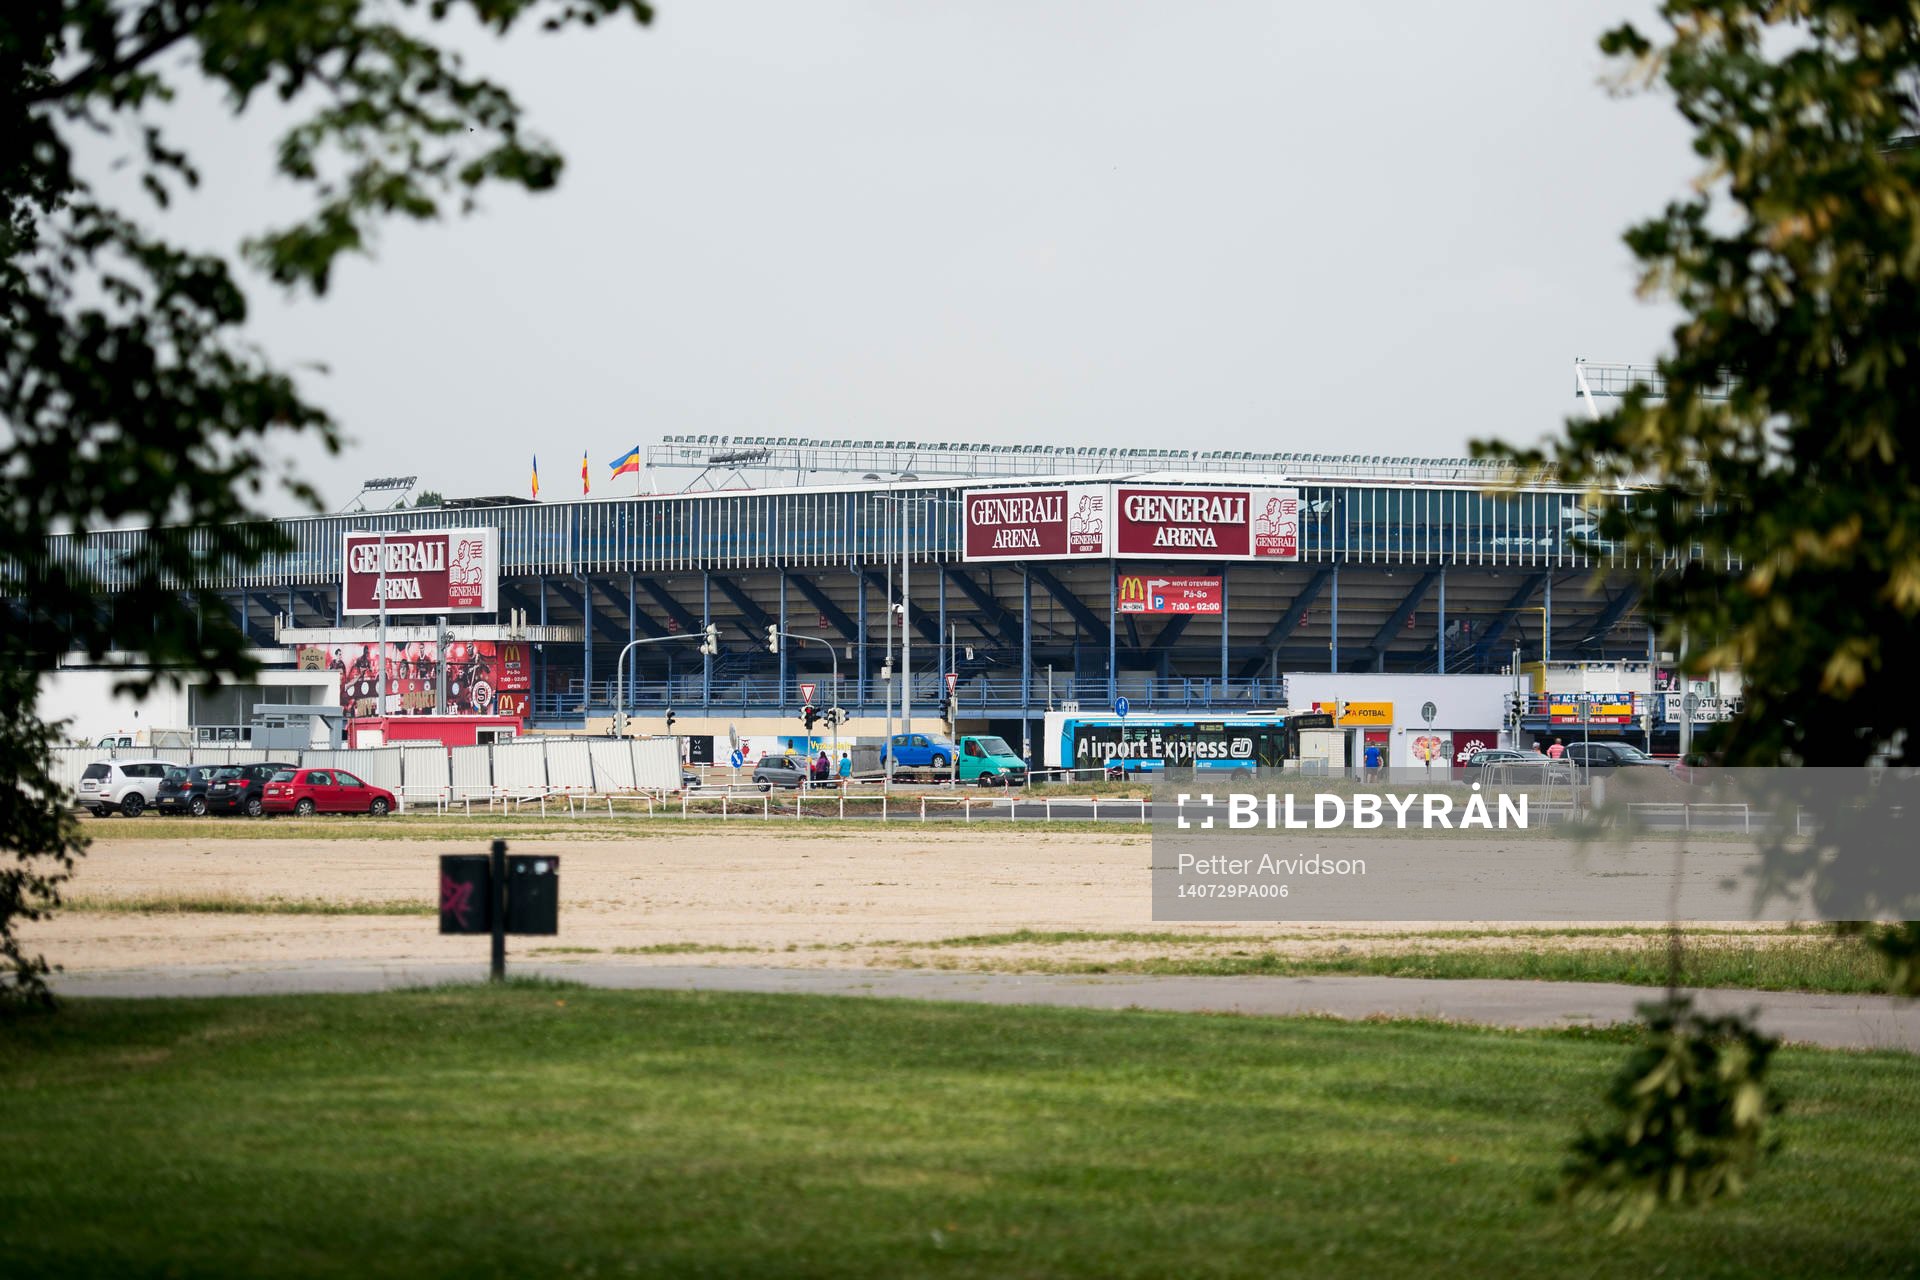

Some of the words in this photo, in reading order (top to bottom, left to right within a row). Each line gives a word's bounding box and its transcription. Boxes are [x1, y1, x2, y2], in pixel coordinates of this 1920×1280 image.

[971, 496, 1063, 525] GENERALI
[1124, 495, 1246, 524] GENERALI
[992, 528, 1041, 548] ARENA
[1070, 534, 1103, 545] GENERALI
[1153, 527, 1218, 548] ARENA
[1256, 537, 1297, 547] GENERALI
[372, 577, 422, 601] ARENA
[450, 585, 481, 597] GENERALI
[1155, 597, 1164, 608] P
[1077, 736, 1149, 764] Airport
[1151, 736, 1227, 764] Express
